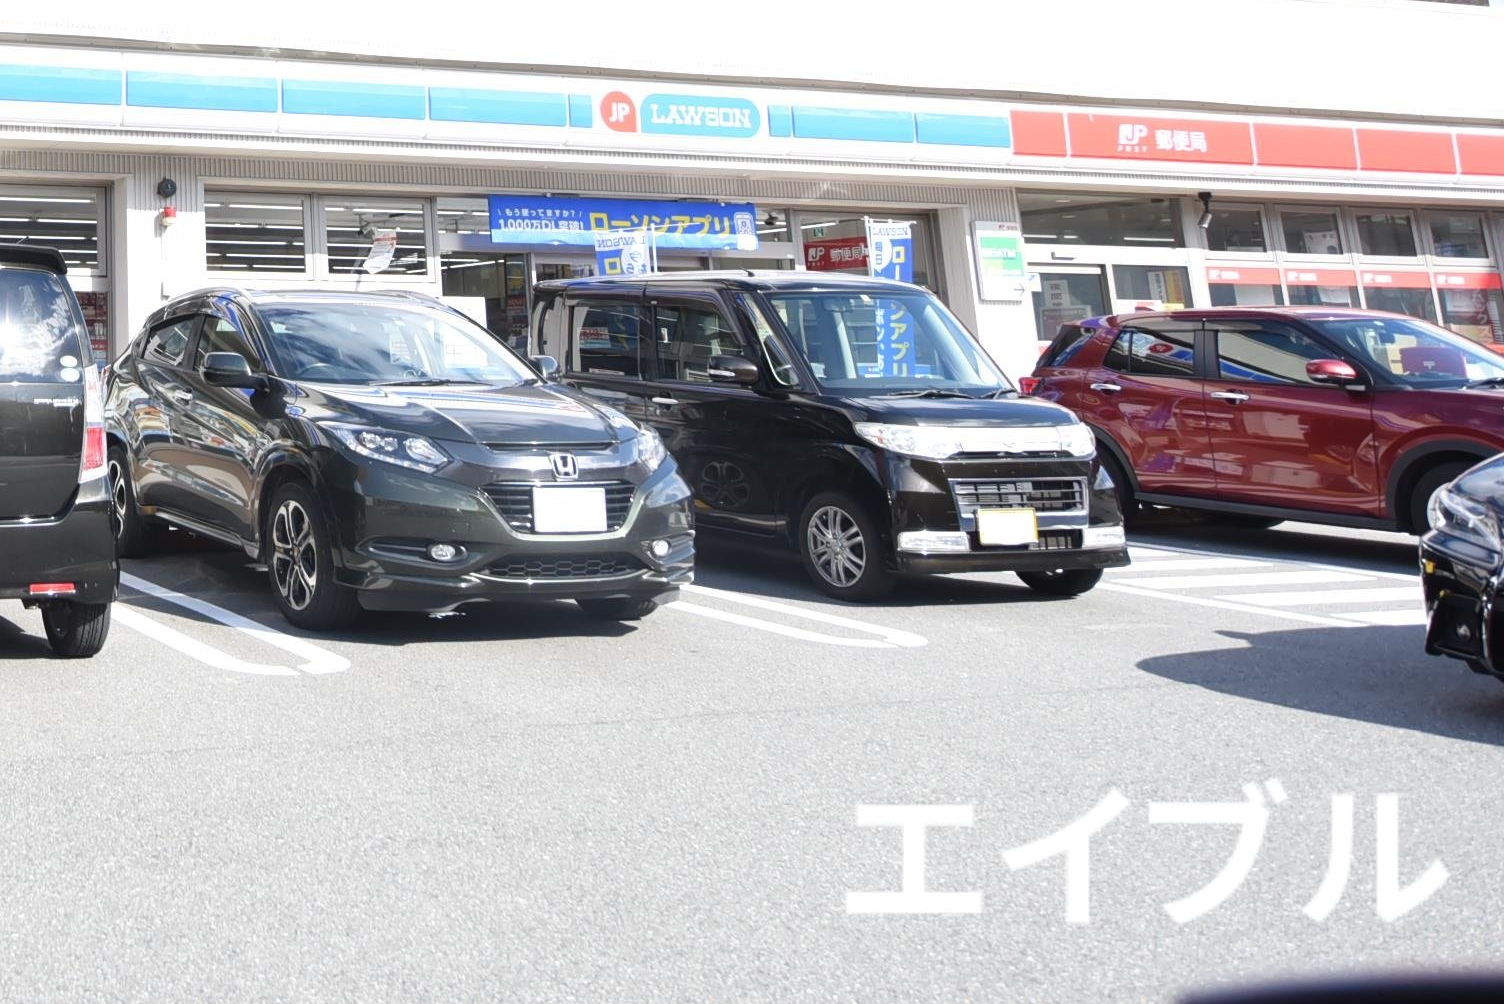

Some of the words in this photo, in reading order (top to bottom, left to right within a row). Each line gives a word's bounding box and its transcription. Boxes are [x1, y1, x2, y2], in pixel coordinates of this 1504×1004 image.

[608, 102, 630, 123] JP
[650, 103, 752, 129] LAWSON
[1155, 129, 1207, 153] 郵便局
[589, 212, 730, 237] ローソンアプリ
